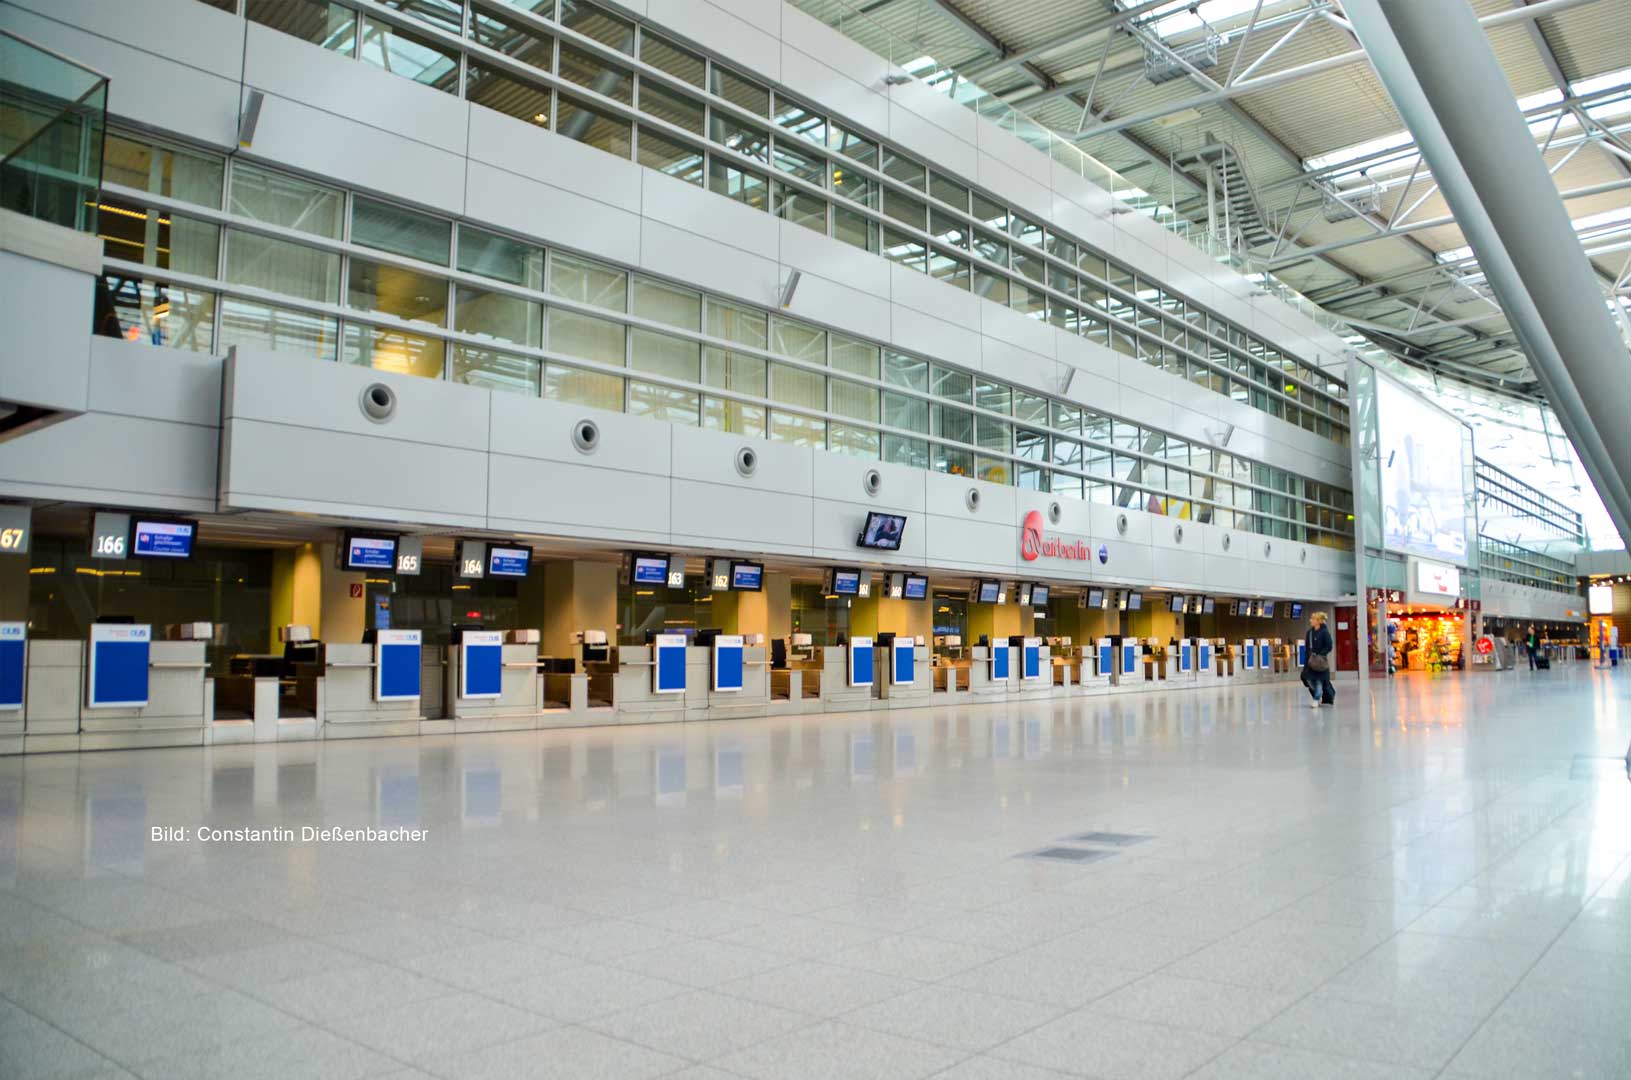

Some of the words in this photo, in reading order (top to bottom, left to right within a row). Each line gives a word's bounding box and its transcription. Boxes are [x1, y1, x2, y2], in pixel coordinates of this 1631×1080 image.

[0, 528, 24, 549] 67
[97, 536, 125, 554] 166
[1042, 536, 1091, 561] airberlin
[397, 555, 417, 571] 165
[464, 559, 482, 574] 164
[668, 572, 682, 585] 163
[714, 575, 728, 588] 162
